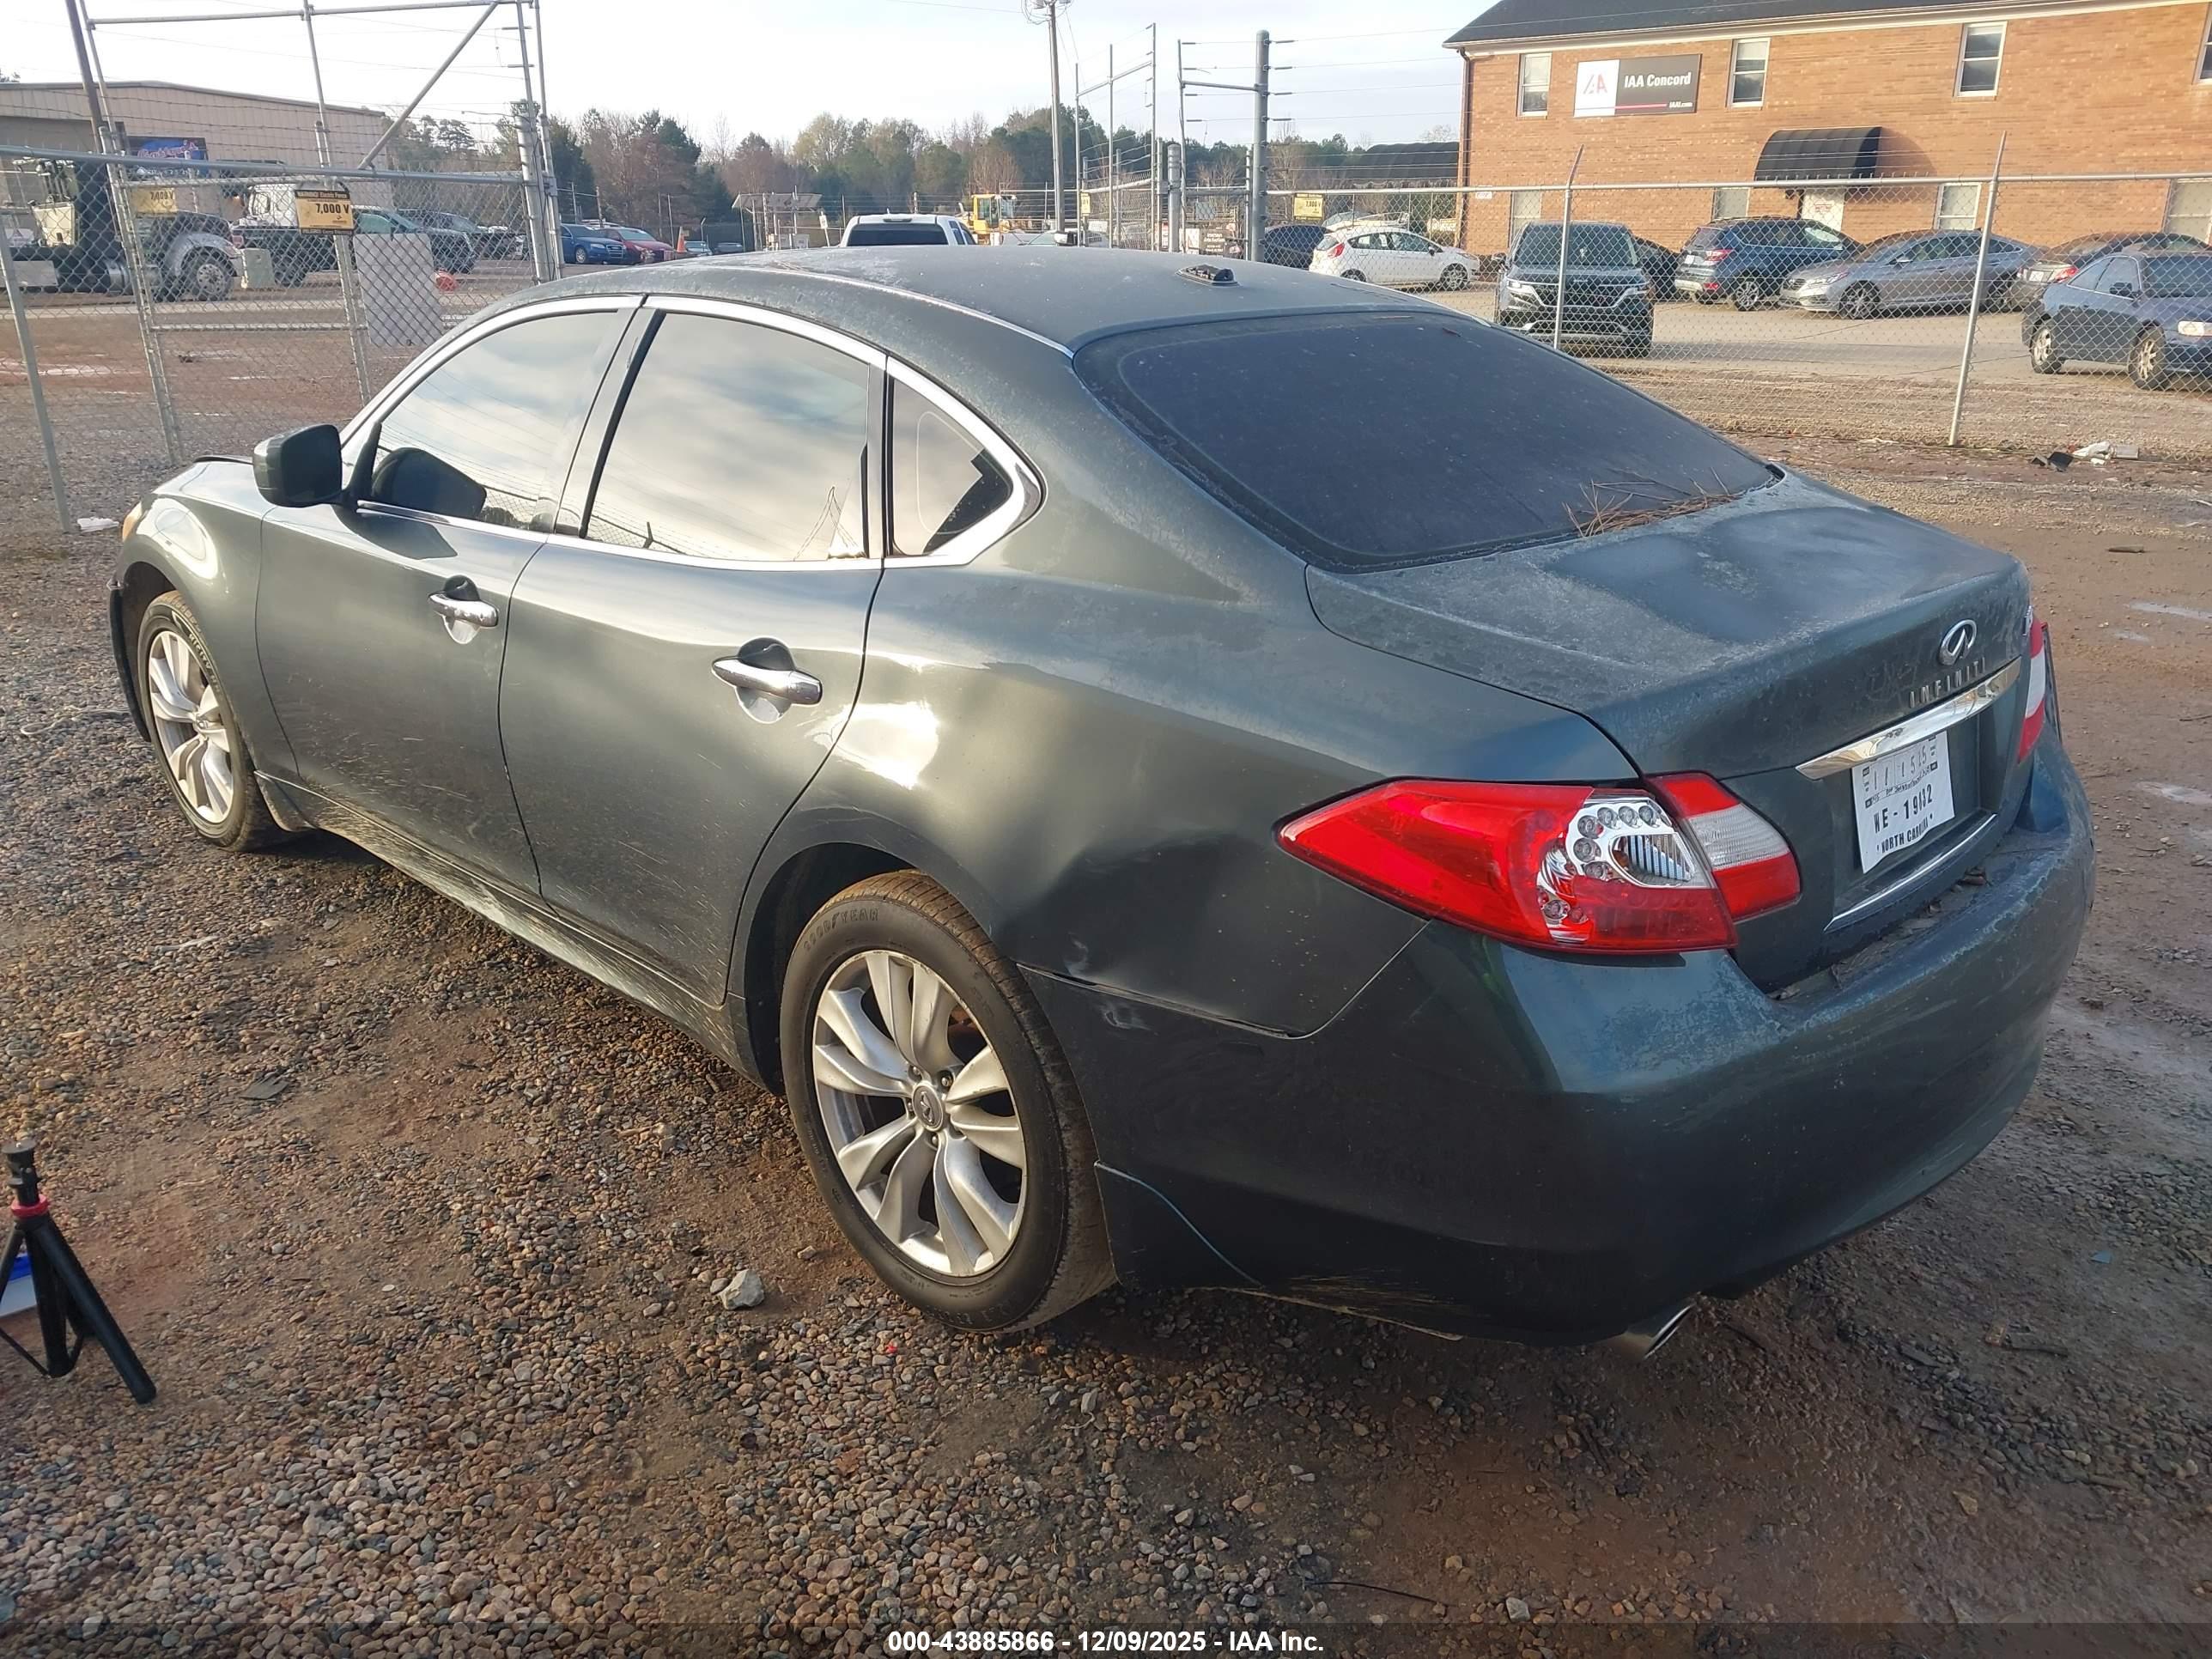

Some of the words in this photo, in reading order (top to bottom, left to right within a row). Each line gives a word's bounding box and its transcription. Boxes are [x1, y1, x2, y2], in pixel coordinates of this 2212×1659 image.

[1624, 75, 1644, 88] IAA
[1646, 71, 1692, 88] Concord
[315, 203, 342, 215] 7,000
[343, 204, 349, 214] V
[1910, 656, 1985, 708] INFINITI
[1881, 831, 1905, 854] NORTH
